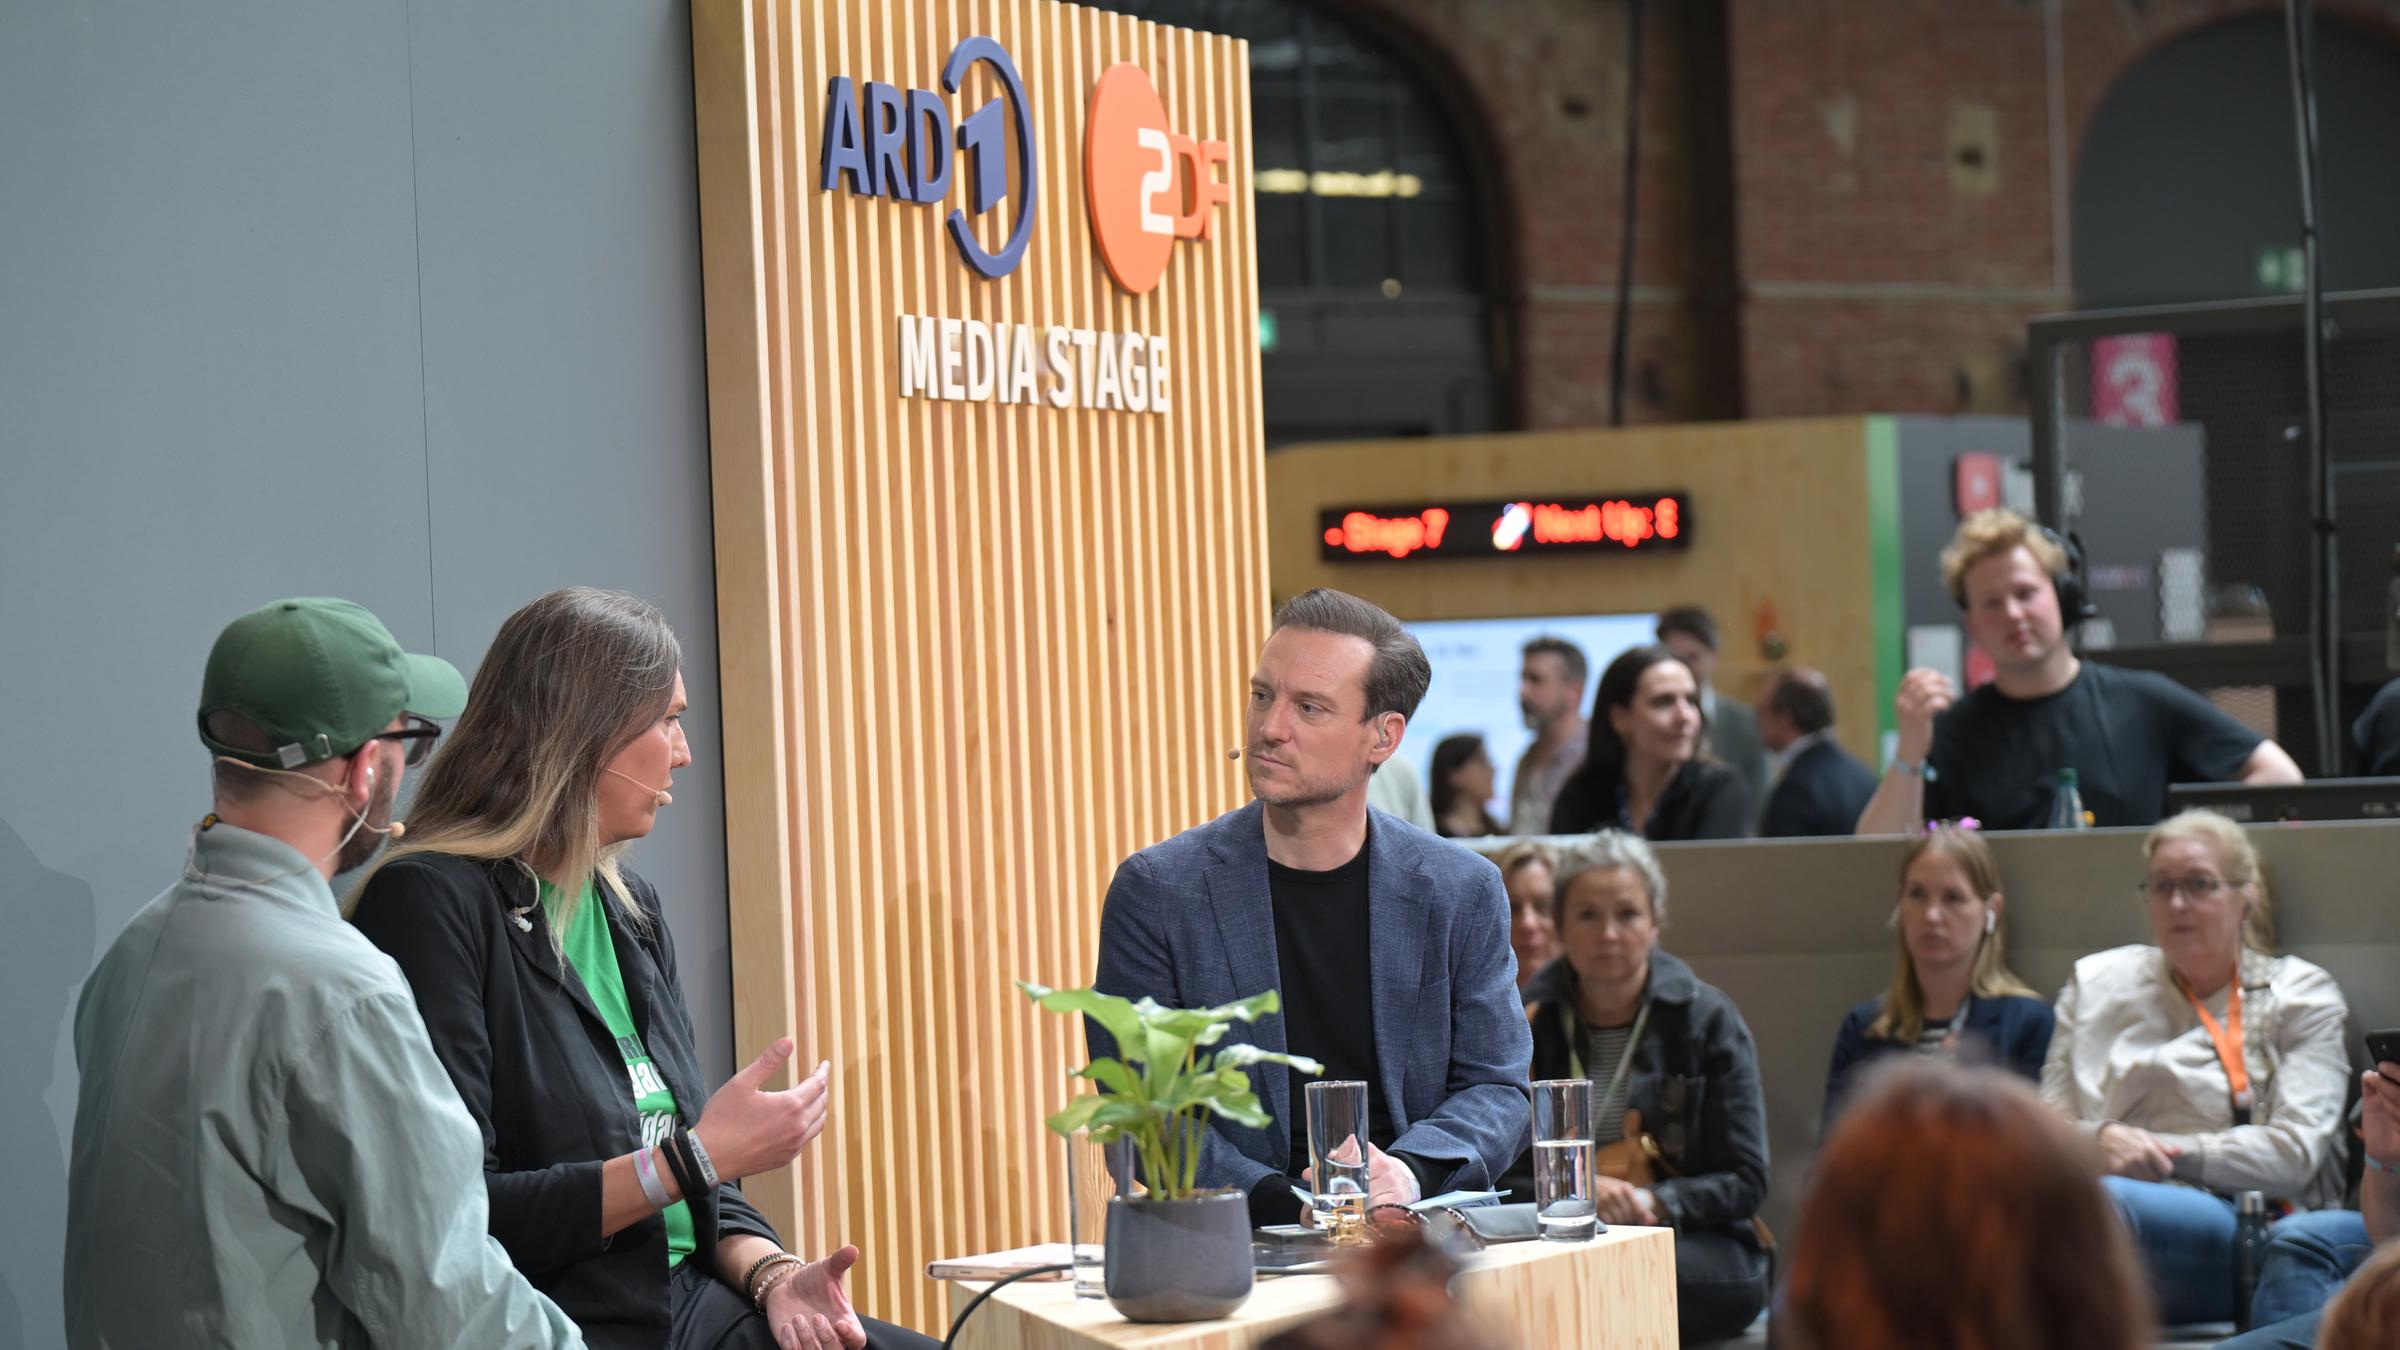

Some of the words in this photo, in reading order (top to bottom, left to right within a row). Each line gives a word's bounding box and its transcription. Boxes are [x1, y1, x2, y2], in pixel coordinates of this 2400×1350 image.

[821, 76, 953, 204] ARD
[899, 314, 1040, 404] MEDIA
[1047, 325, 1172, 413] STAGE
